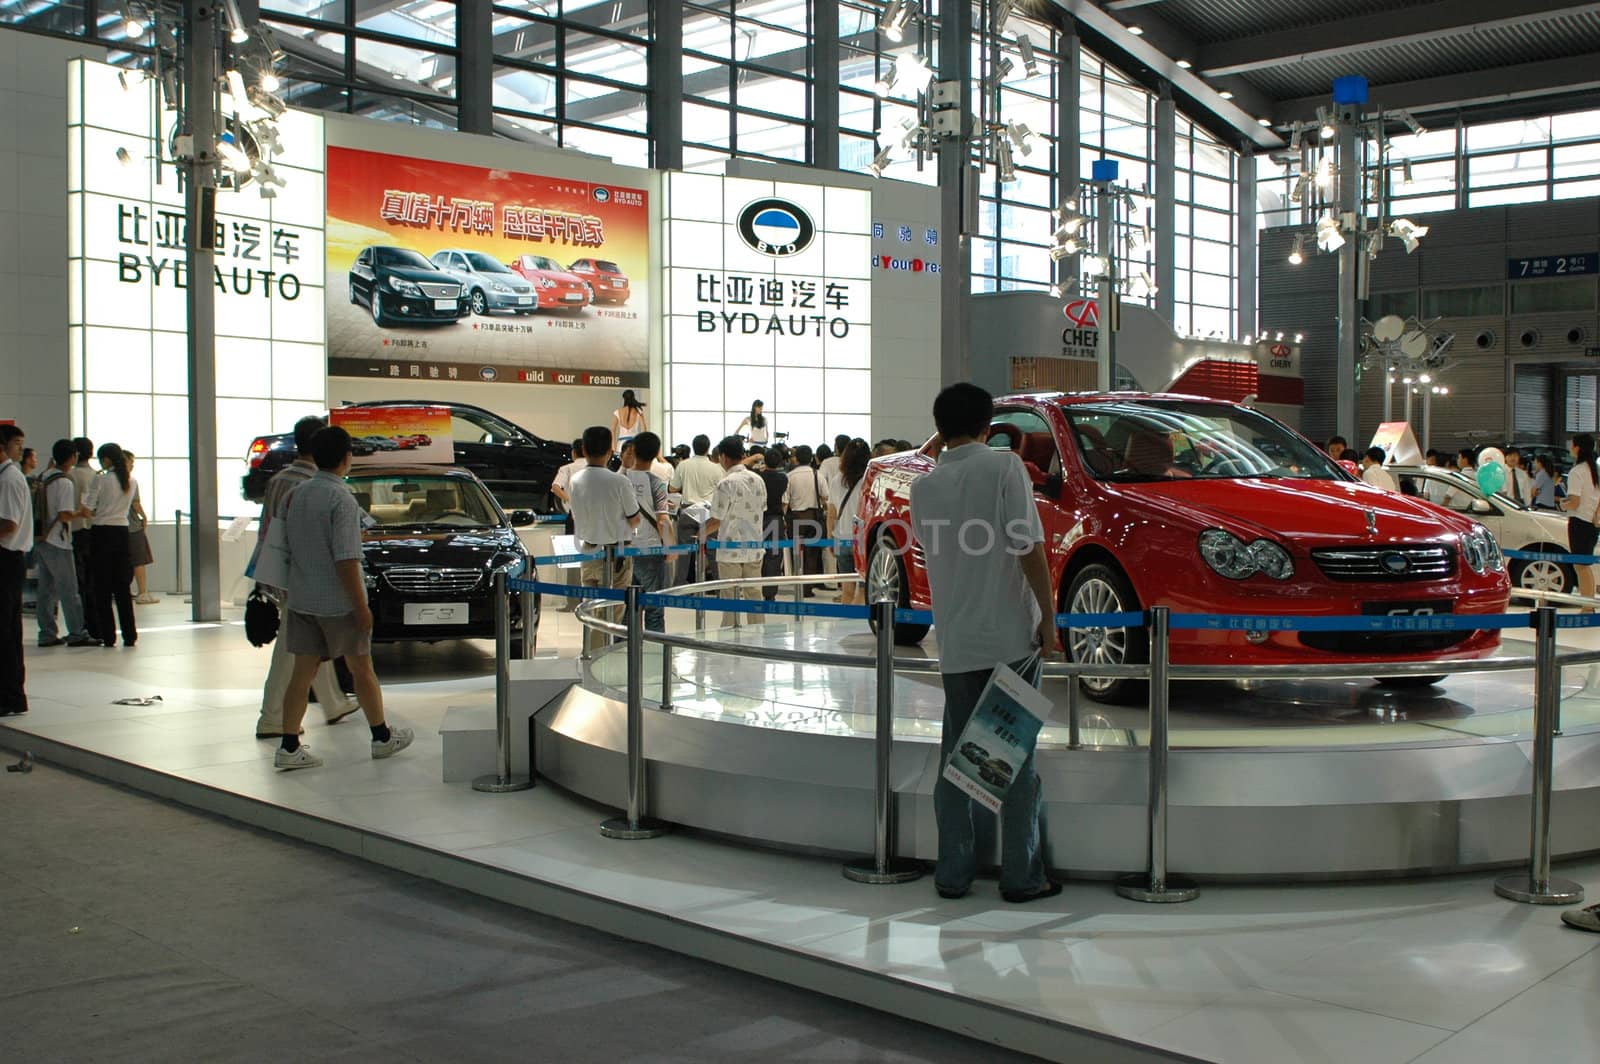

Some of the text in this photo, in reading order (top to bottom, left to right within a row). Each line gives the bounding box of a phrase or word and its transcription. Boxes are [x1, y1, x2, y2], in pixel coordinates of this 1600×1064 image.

[381, 189, 605, 245] 真情十万辆 感恩千万家
[757, 241, 797, 255] BYD
[1520, 261, 1529, 276] 7
[1556, 258, 1566, 273] 2
[697, 274, 850, 310] 比亚迪汽车
[518, 369, 620, 385] Build Your Dreams
